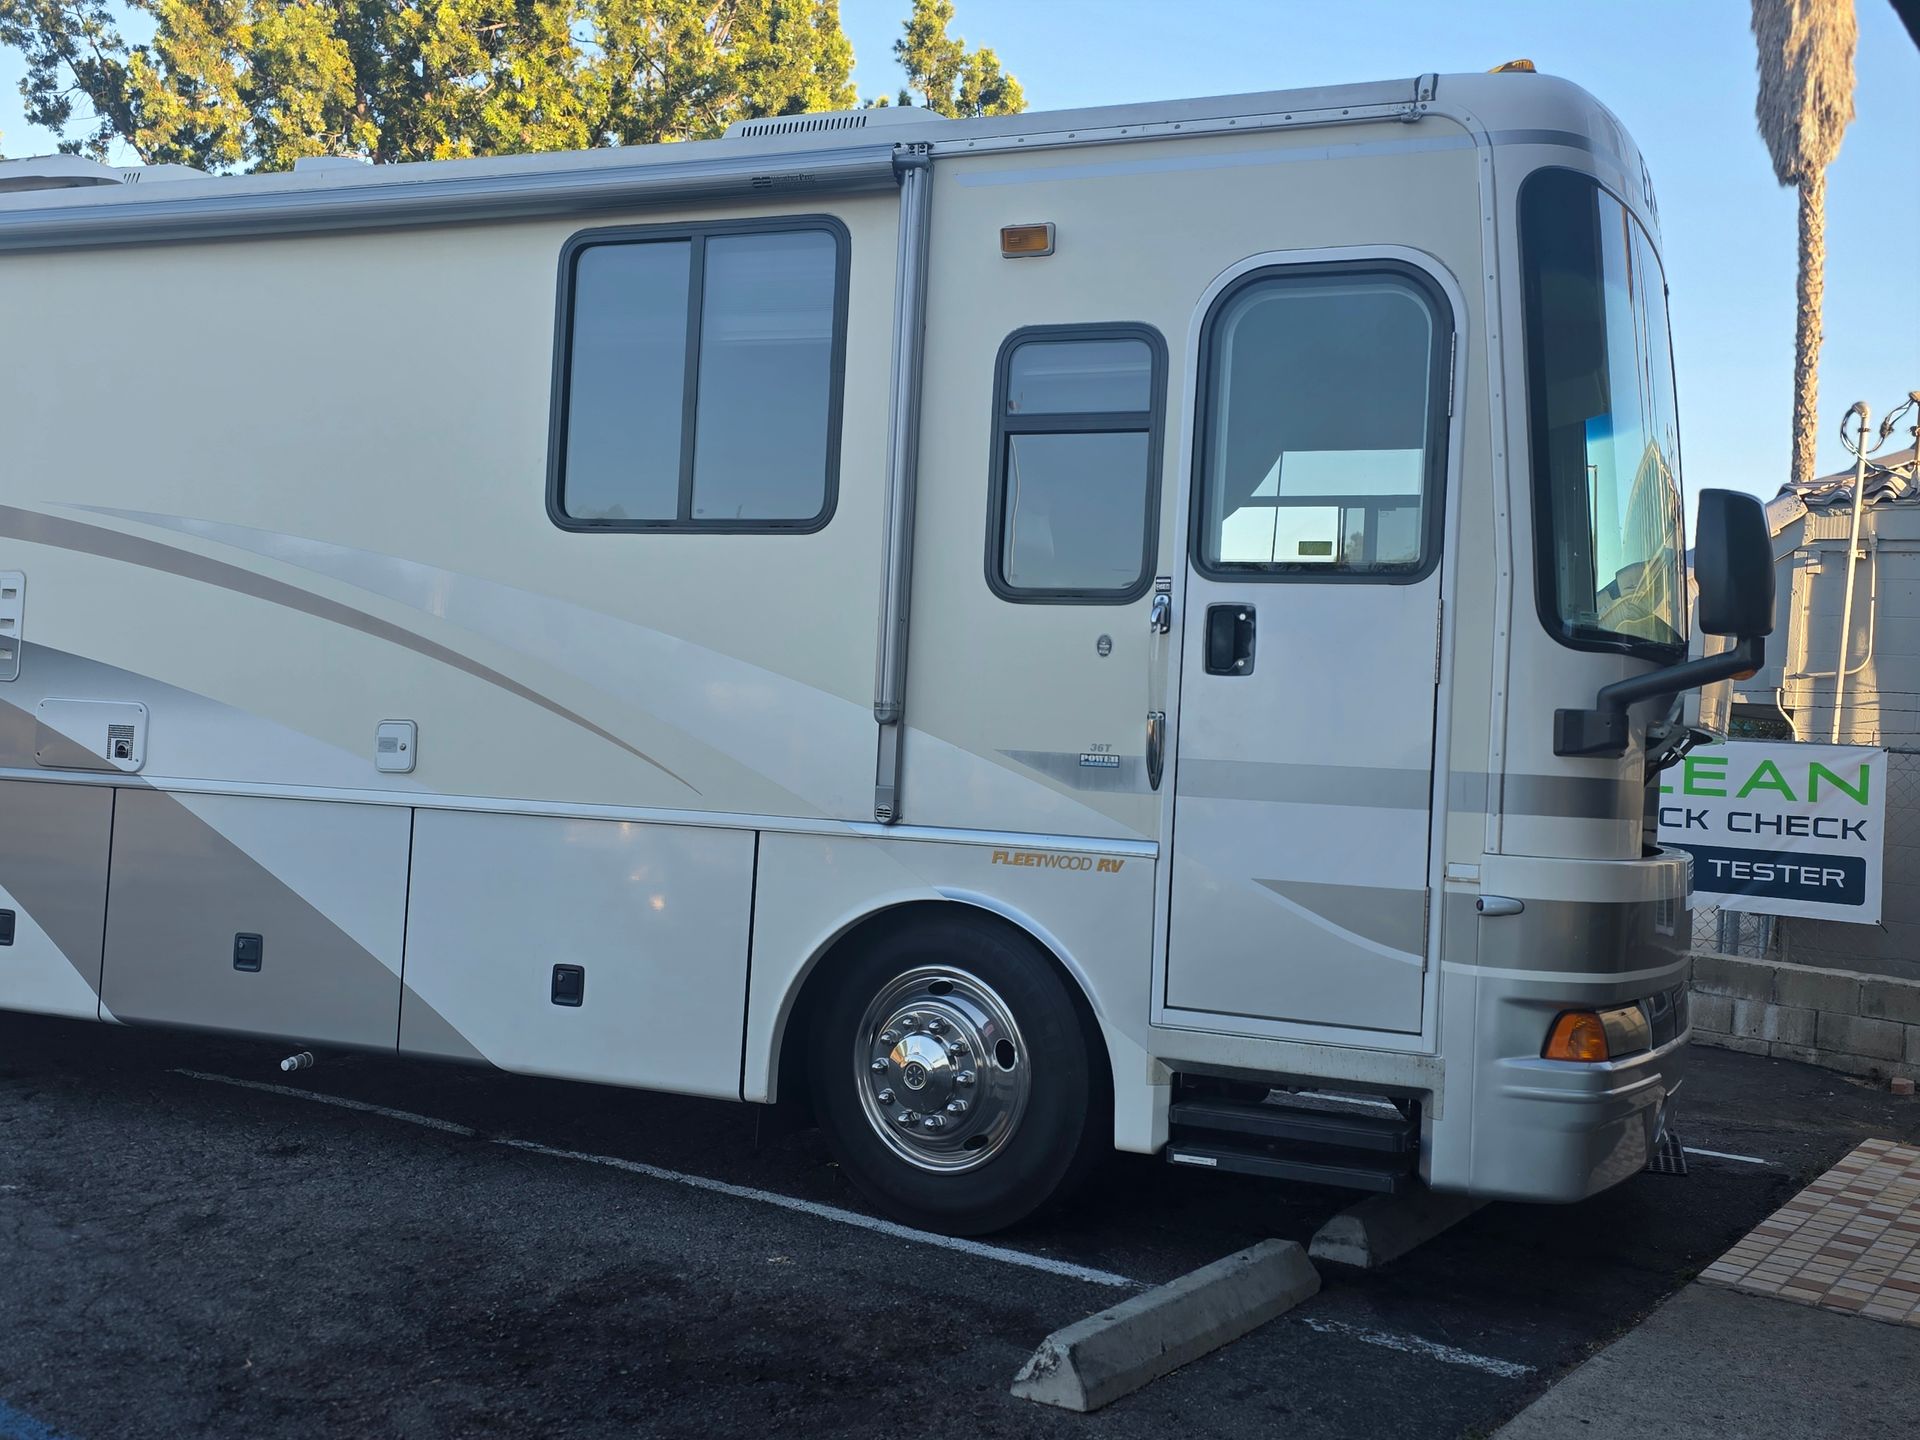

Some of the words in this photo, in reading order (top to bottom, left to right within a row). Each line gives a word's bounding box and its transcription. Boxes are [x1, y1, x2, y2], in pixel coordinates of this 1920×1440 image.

[1090, 743, 1113, 753] 36T
[1727, 811, 1868, 842] CHECK
[992, 850, 1092, 871] FLEETWOOD
[1096, 857, 1125, 873] RV
[1708, 858, 1846, 888] TESTER
